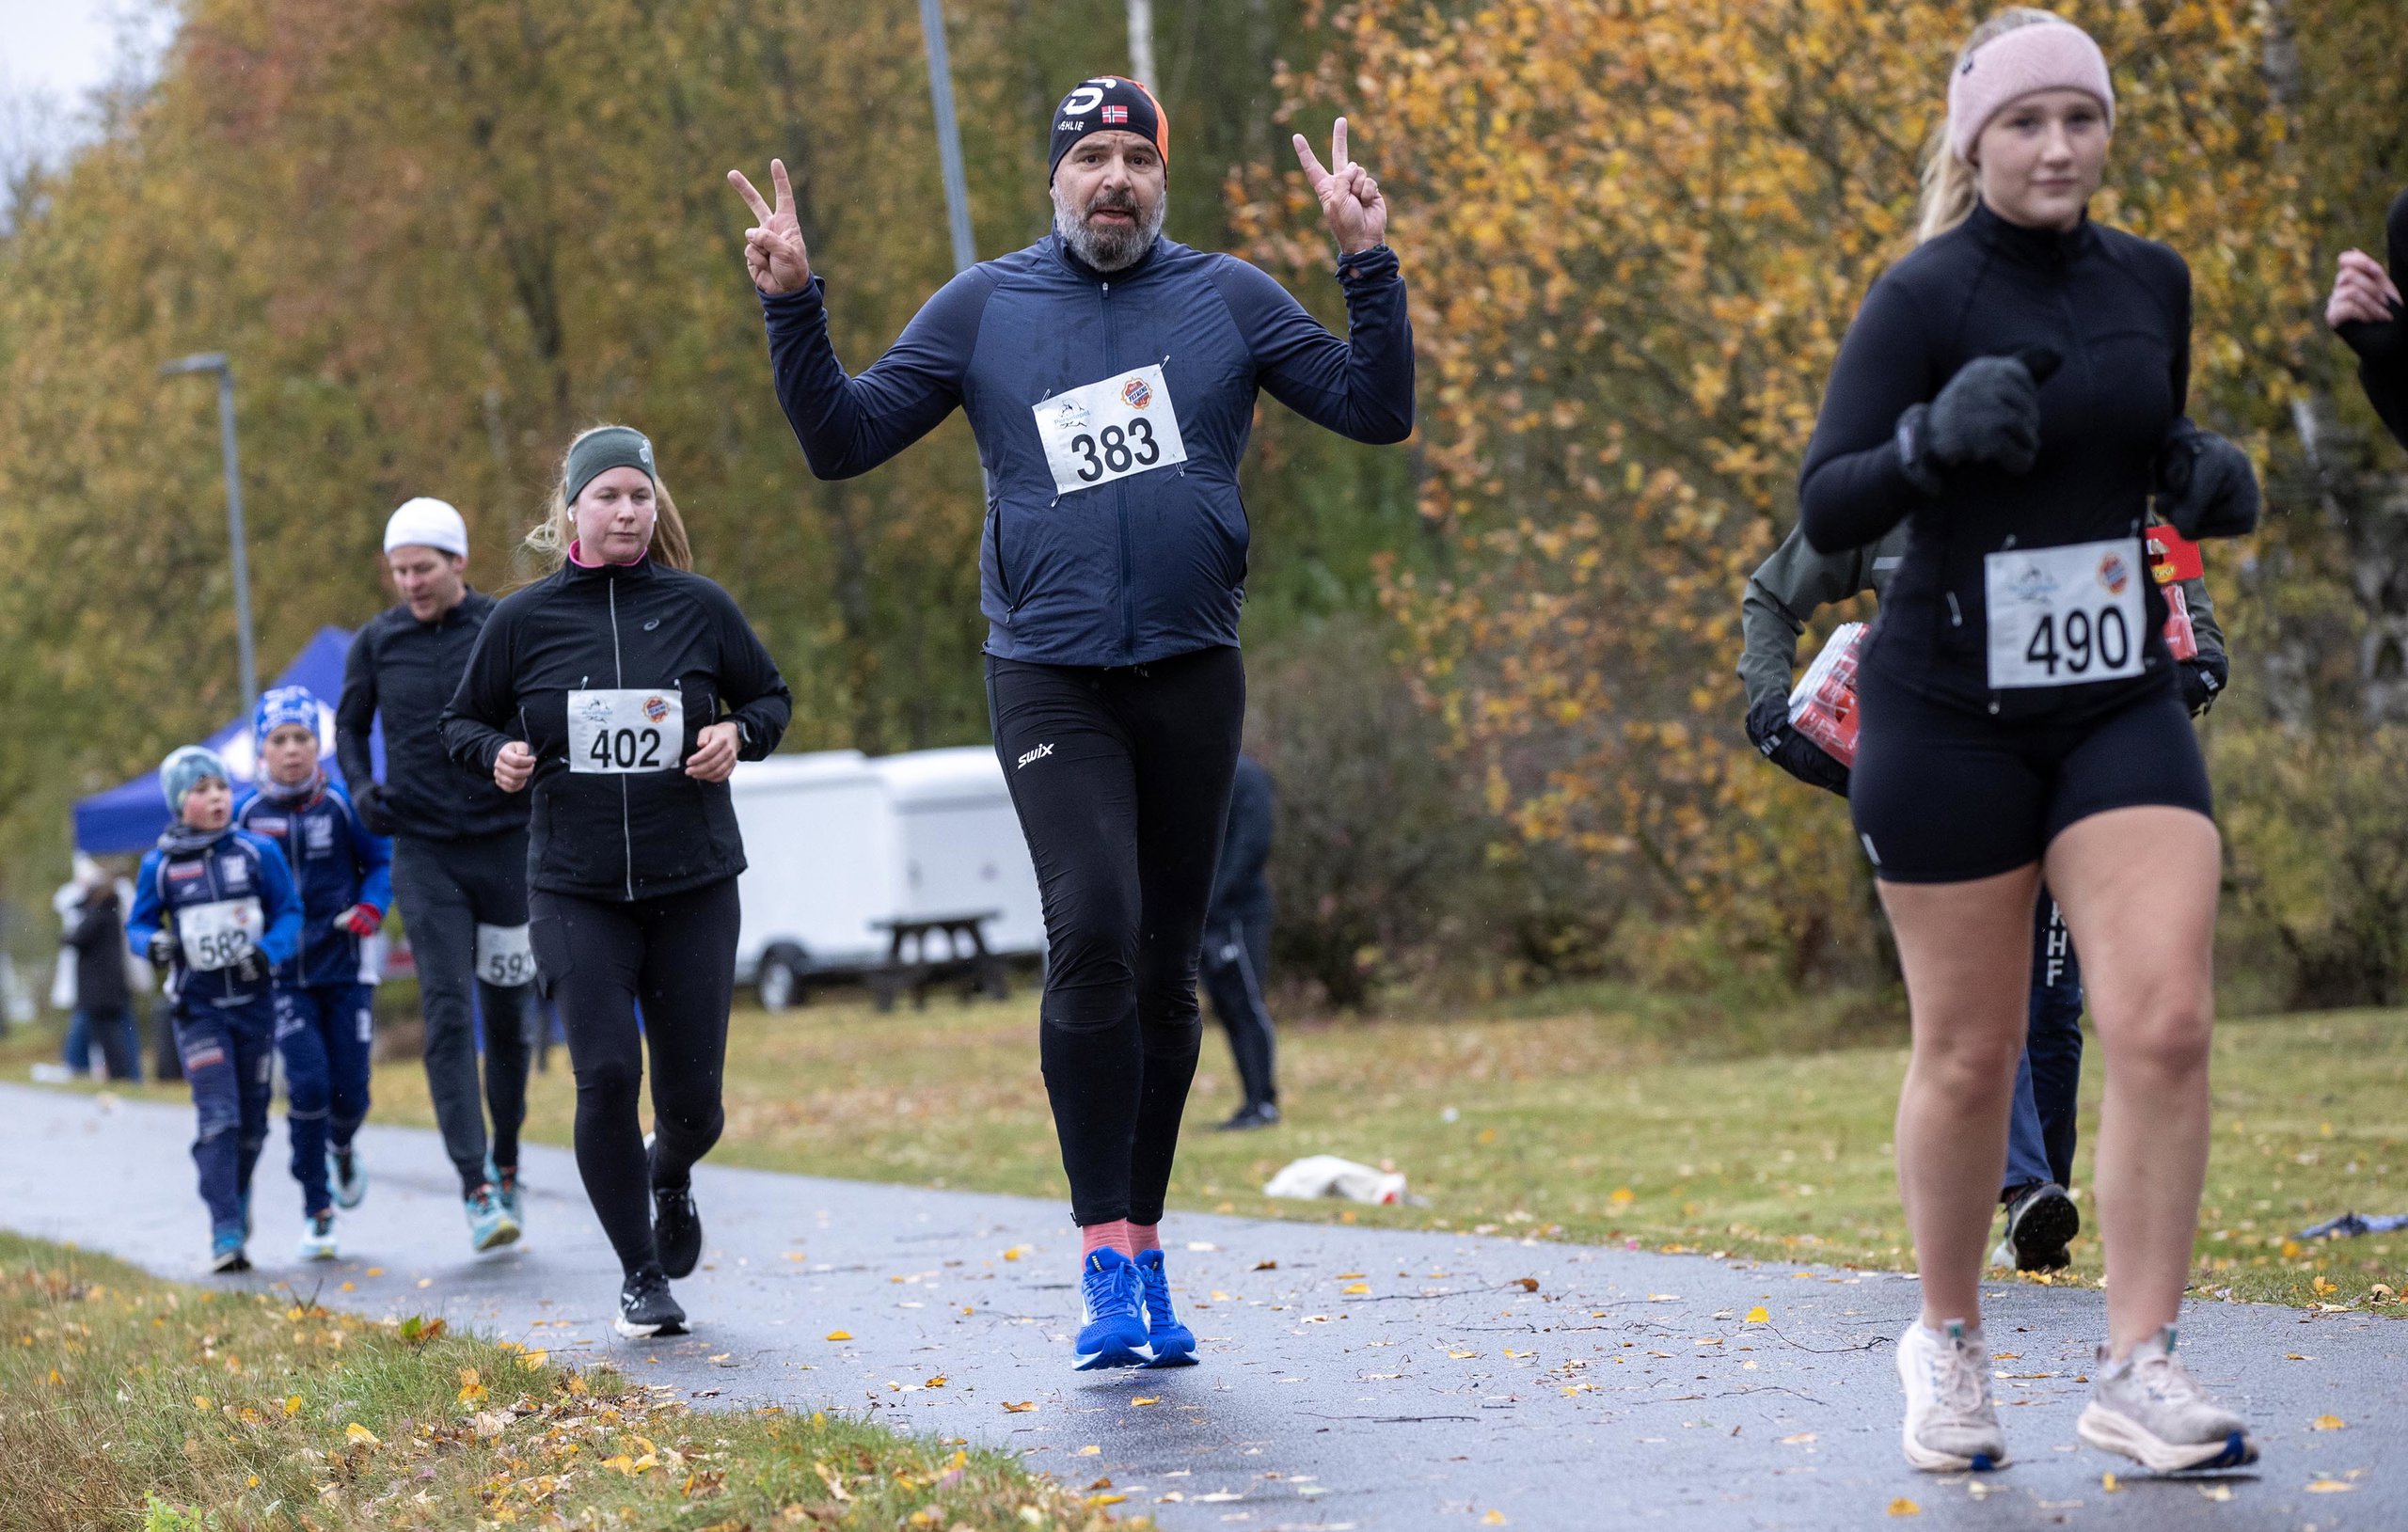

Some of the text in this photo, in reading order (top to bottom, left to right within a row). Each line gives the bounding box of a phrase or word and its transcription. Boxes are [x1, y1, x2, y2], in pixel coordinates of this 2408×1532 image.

[1071, 417, 1160, 482] 383
[2026, 605, 2129, 675] 490
[590, 727, 661, 769] 402
[490, 950, 533, 981] 59
